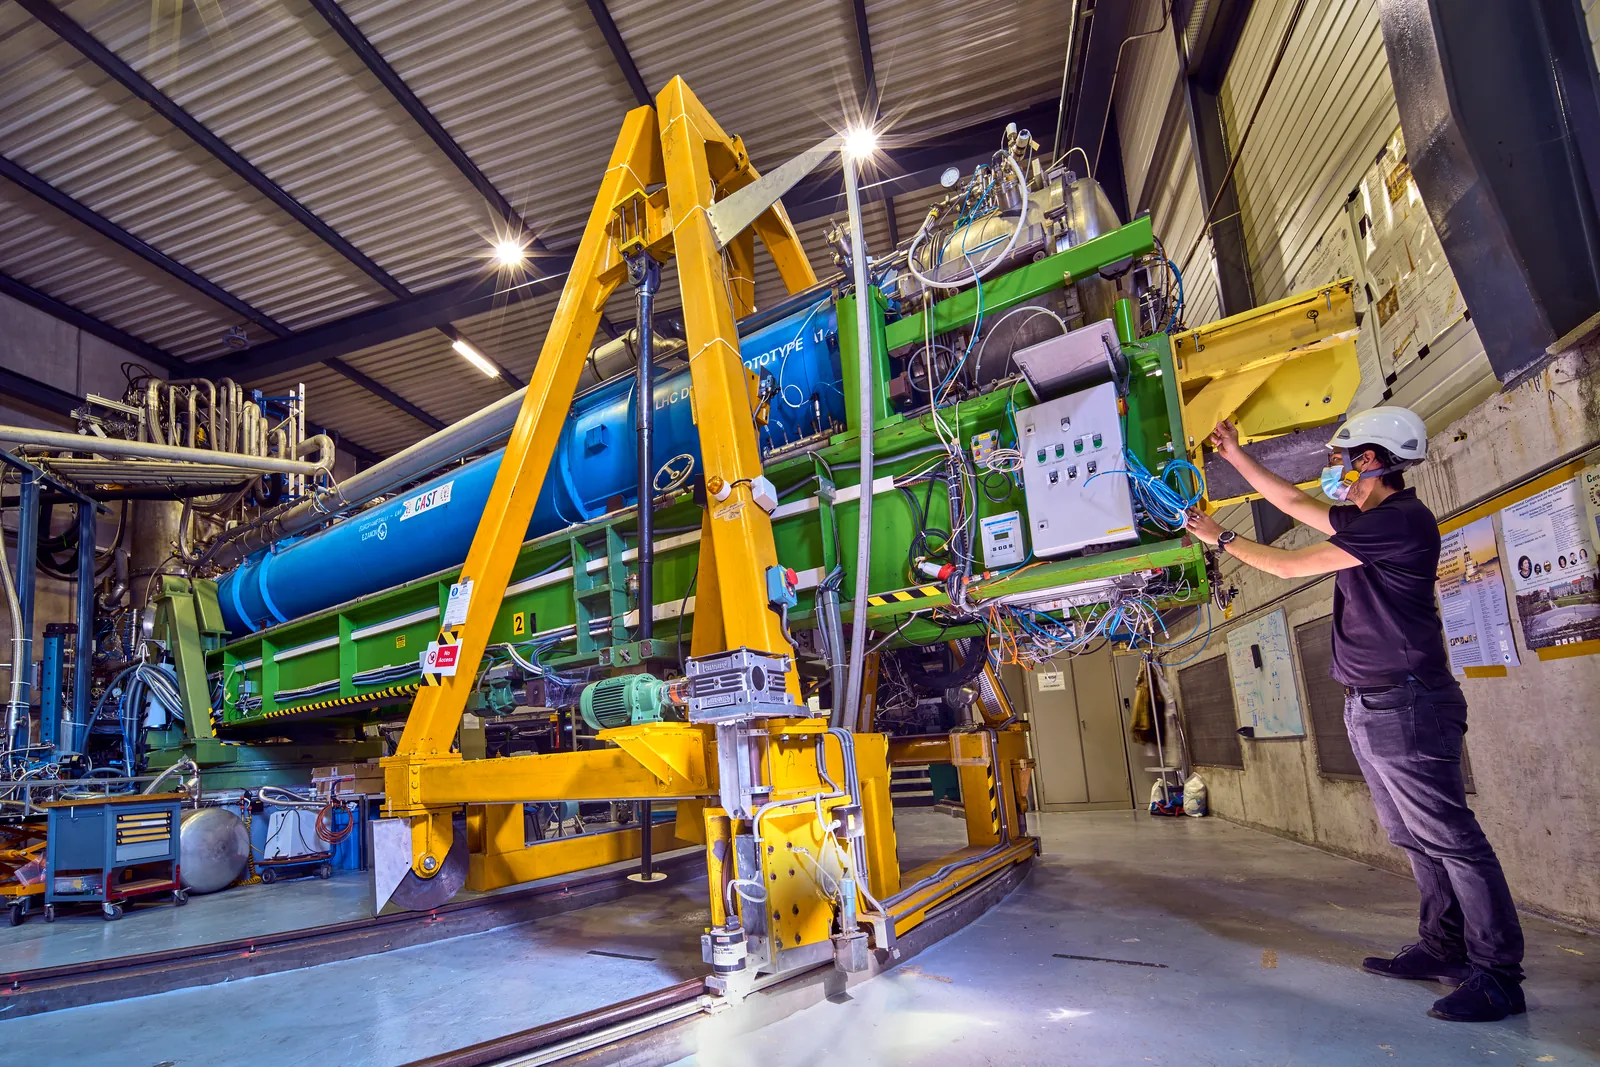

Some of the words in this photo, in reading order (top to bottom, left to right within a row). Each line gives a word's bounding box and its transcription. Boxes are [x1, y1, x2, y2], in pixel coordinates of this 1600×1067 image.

[656, 391, 678, 411] LHC
[743, 337, 804, 370] OTOTYPE
[414, 490, 438, 512] CAST
[515, 616, 522, 632] 2
